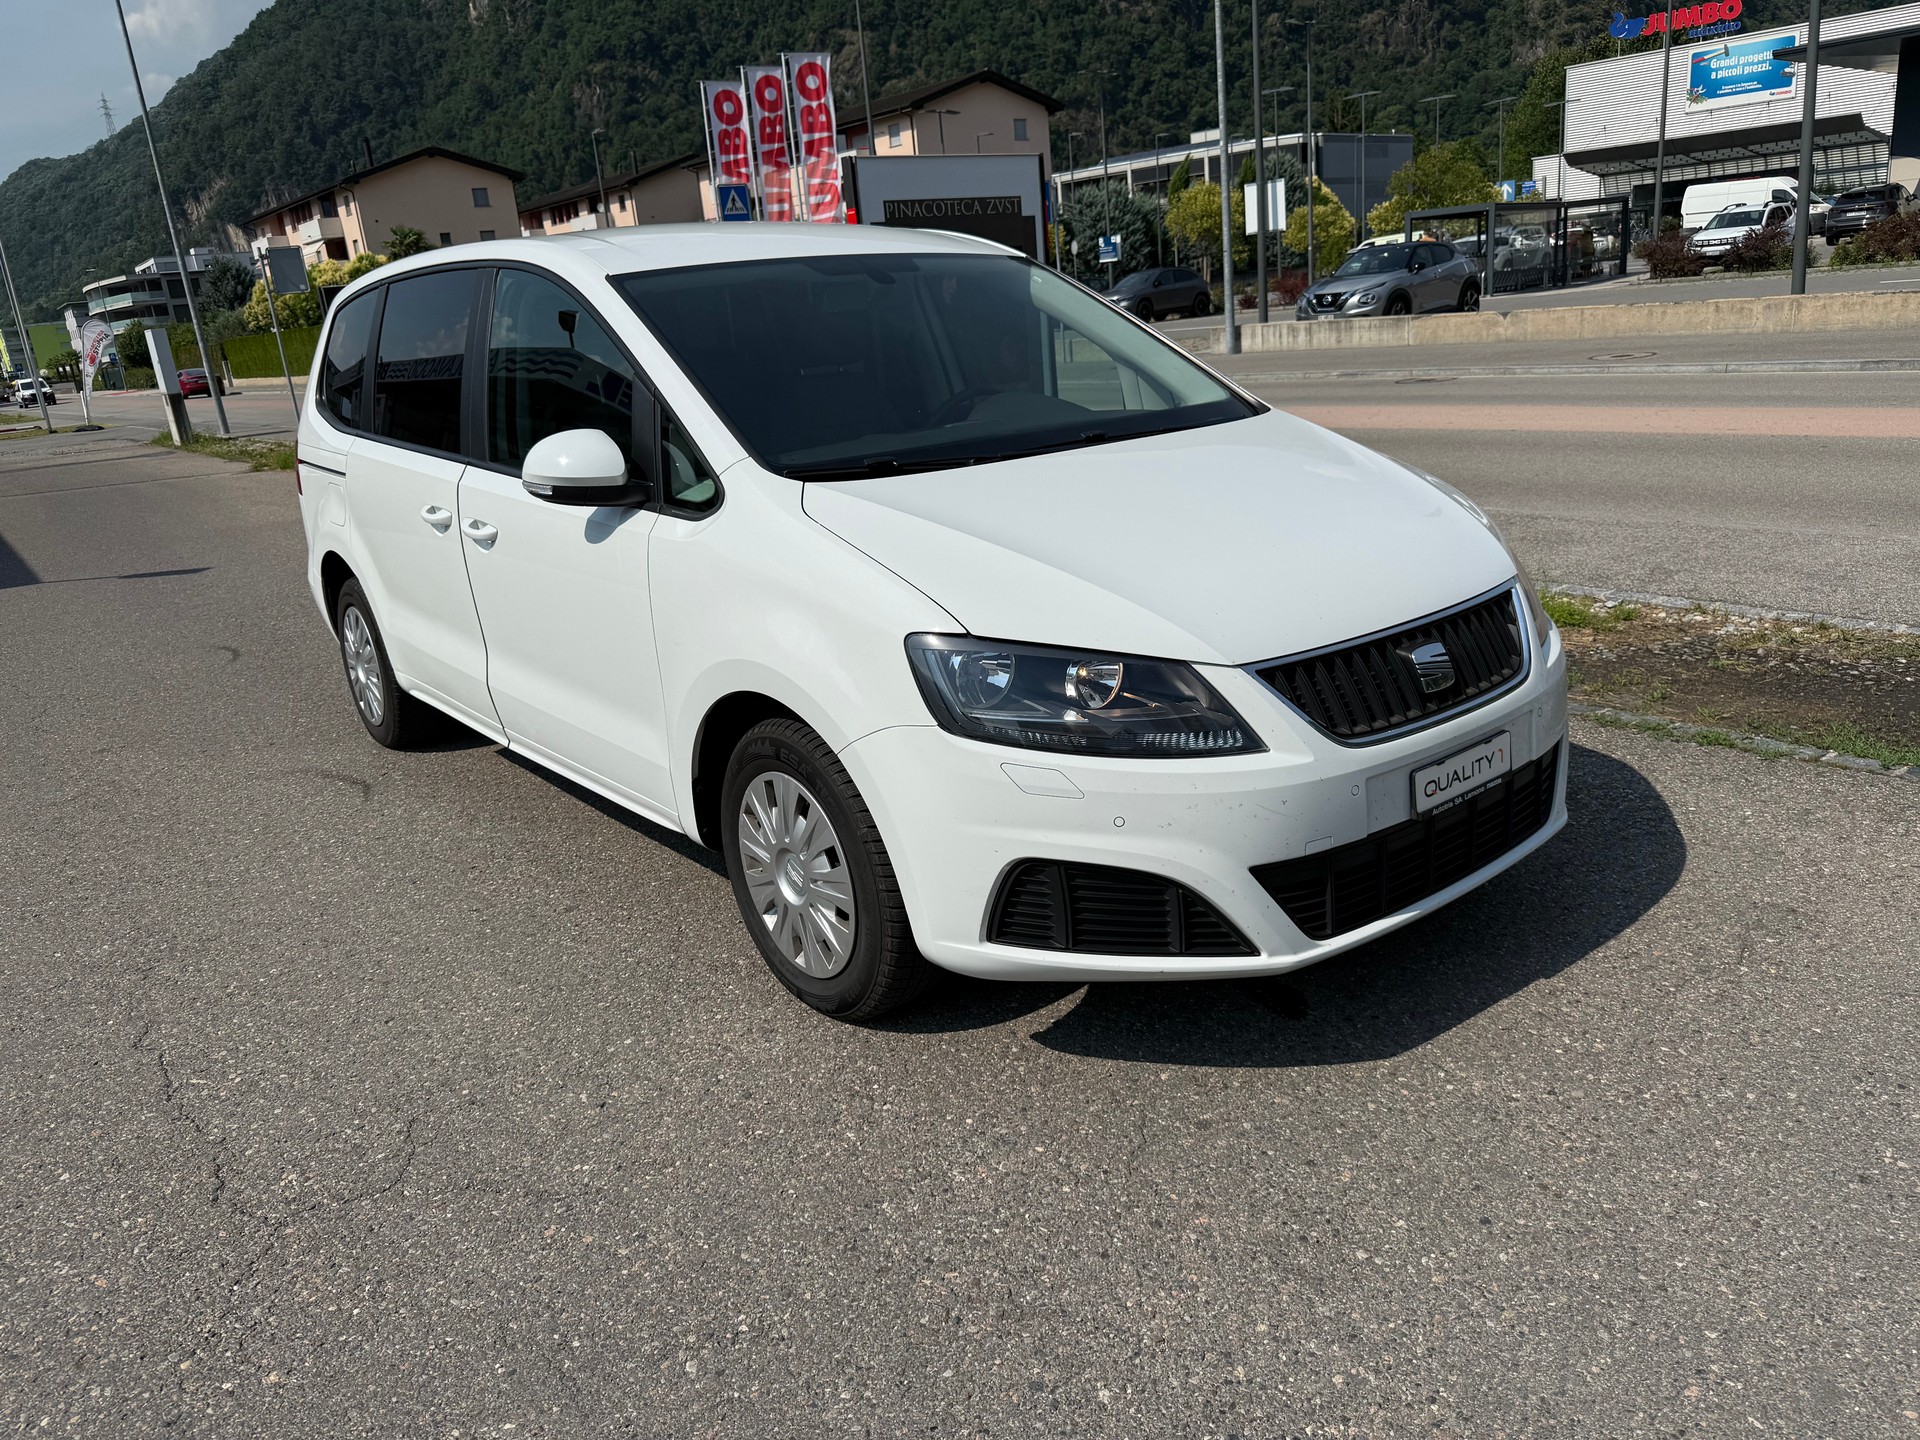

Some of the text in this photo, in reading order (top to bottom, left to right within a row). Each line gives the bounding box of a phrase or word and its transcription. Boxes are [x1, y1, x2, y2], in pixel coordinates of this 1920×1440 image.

[1641, 0, 1742, 36] JUMBO
[1710, 56, 1738, 69] Grandi
[1710, 61, 1772, 79] a piccoli prezzi.
[754, 74, 793, 222] UMBO
[885, 198, 1020, 218] PINACOTECA ZVST
[1424, 751, 1496, 798] QUALITY
